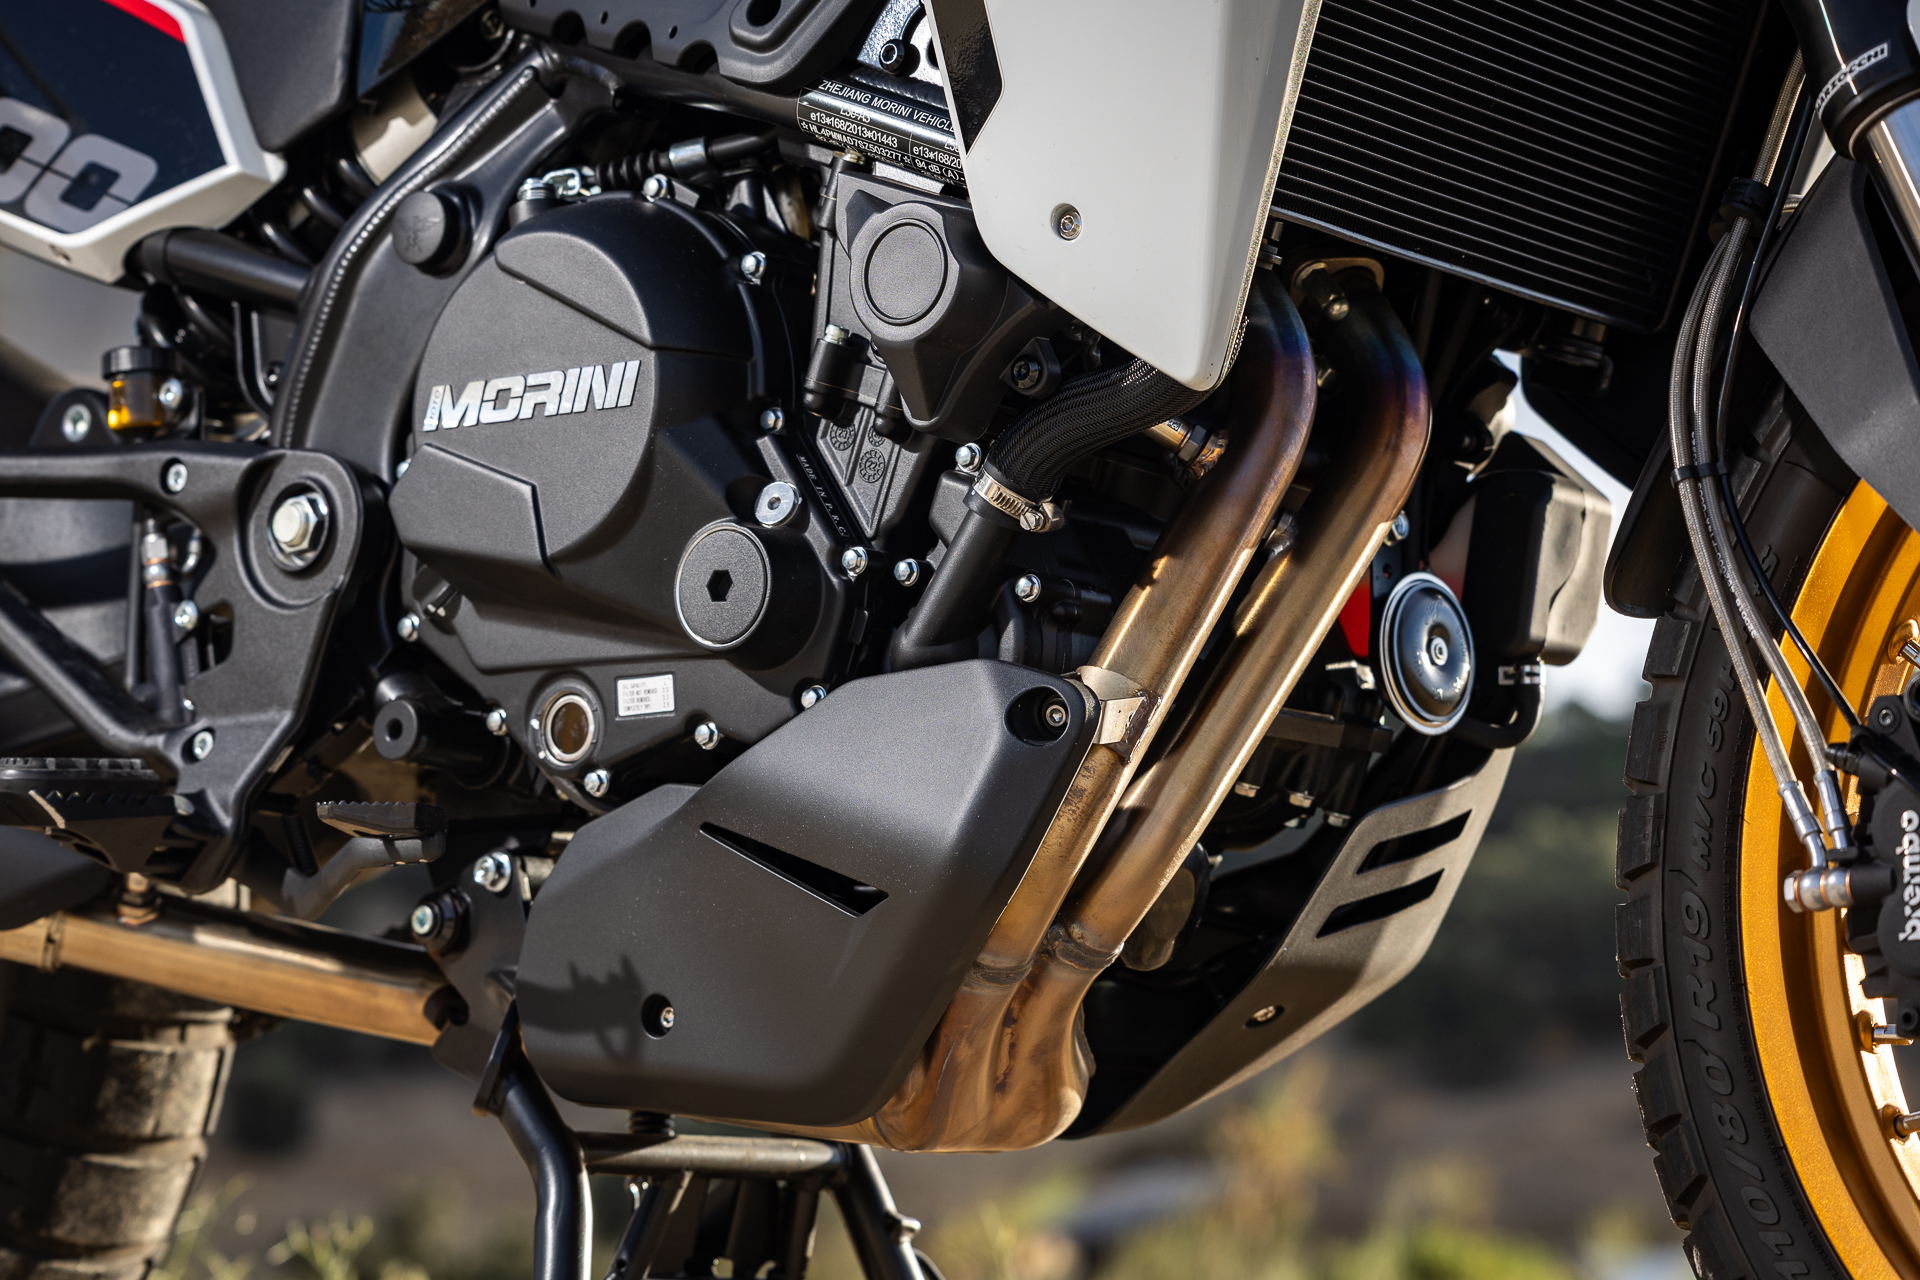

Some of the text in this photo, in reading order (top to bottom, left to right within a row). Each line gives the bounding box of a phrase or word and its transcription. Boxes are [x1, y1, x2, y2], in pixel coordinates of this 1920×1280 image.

[818, 80, 871, 104] ZHEJIANG
[871, 98, 911, 118] MORINI
[915, 159, 927, 171] 94
[928, 162, 941, 175] dB
[422, 360, 642, 432] MORINI
[799, 455, 817, 481] MADE
[816, 486, 827, 498] IN
[1734, 719, 1748, 753] THOSE
[1729, 757, 1741, 785] THAN
[1692, 761, 1717, 871] M/C
[1724, 789, 1737, 837] GREATER
[1723, 842, 1732, 855] OR
[1722, 860, 1731, 874] TO
[1895, 809, 1920, 942] brembo
[1722, 878, 1731, 912] EQUAL
[1723, 916, 1734, 956] RATING
[1726, 958, 1737, 992] SPEED
[1731, 995, 1741, 1017] AND
[1734, 1020, 1749, 1052] INDEX
[1742, 1054, 1757, 1083] LOAD
[1706, 1050, 1810, 1280] 110/80
